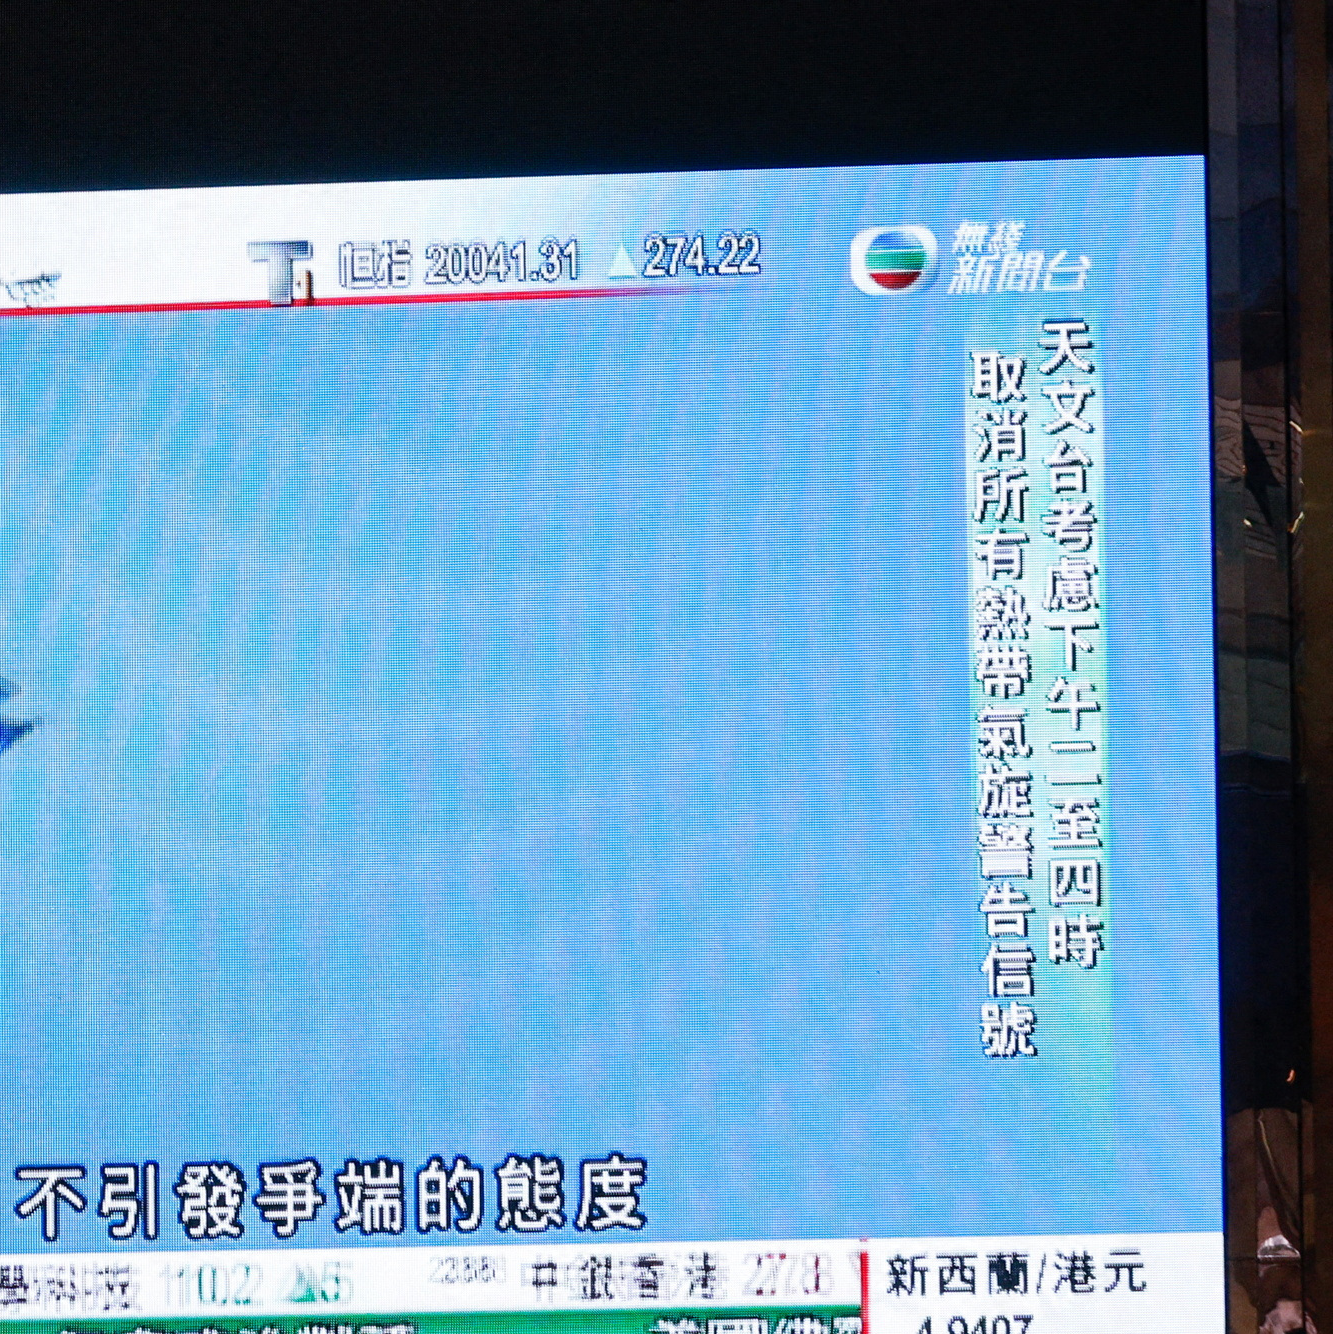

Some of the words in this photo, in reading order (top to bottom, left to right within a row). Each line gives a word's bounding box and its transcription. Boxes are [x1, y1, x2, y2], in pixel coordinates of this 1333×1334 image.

[424, 236, 581, 285] 20041.31
[643, 230, 762, 278] 274.22
[947, 249, 1091, 295] 新聞台
[970, 350, 1038, 1059] 取消所有熱帶氣旋警告信號
